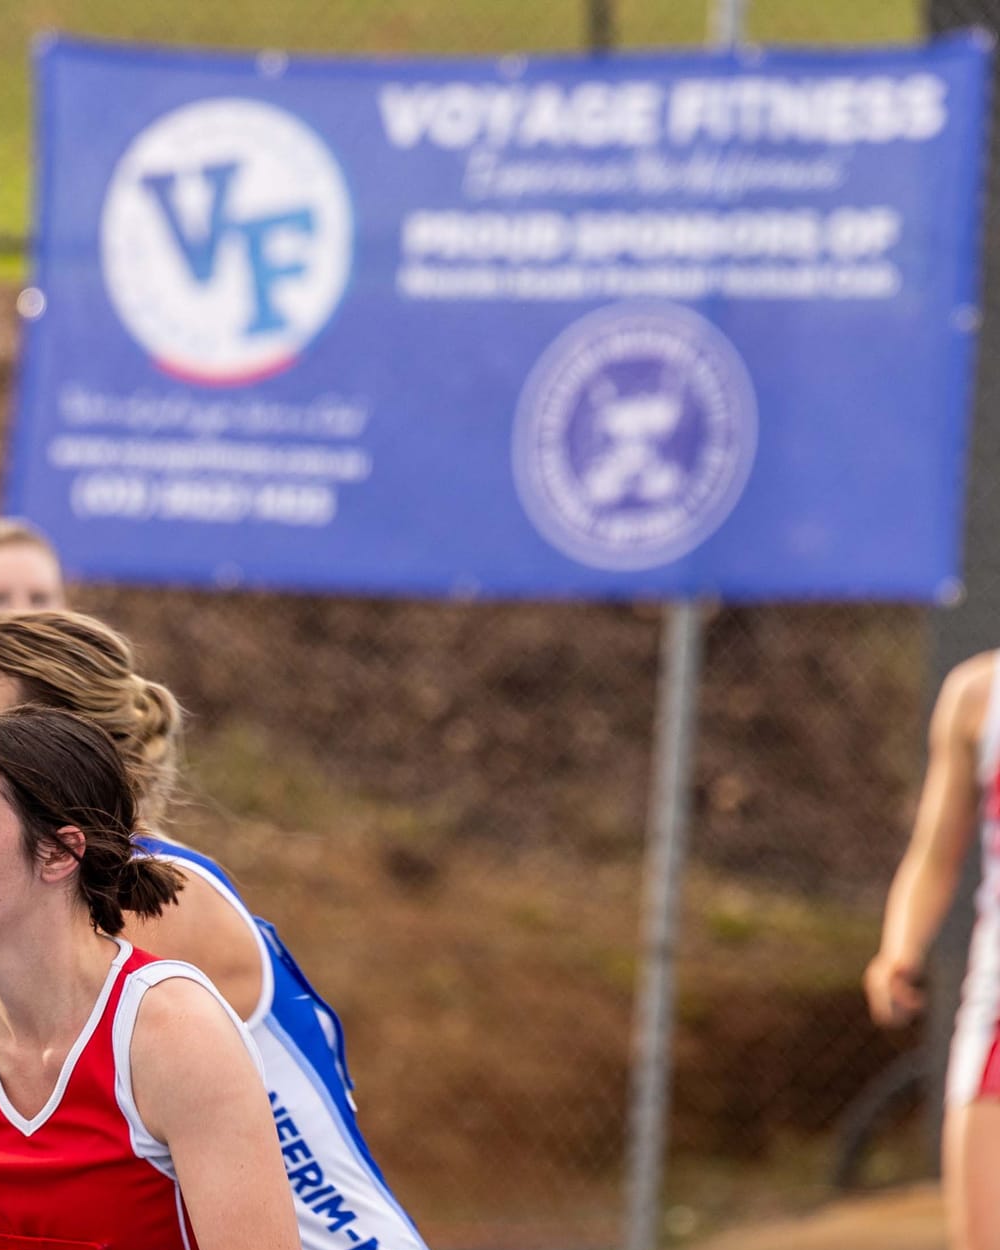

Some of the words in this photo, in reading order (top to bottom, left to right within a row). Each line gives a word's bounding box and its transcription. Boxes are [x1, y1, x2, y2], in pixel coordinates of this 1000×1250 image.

[381, 82, 661, 147] VOYAGE
[670, 74, 947, 146] FITNESS
[140, 160, 316, 337] VF
